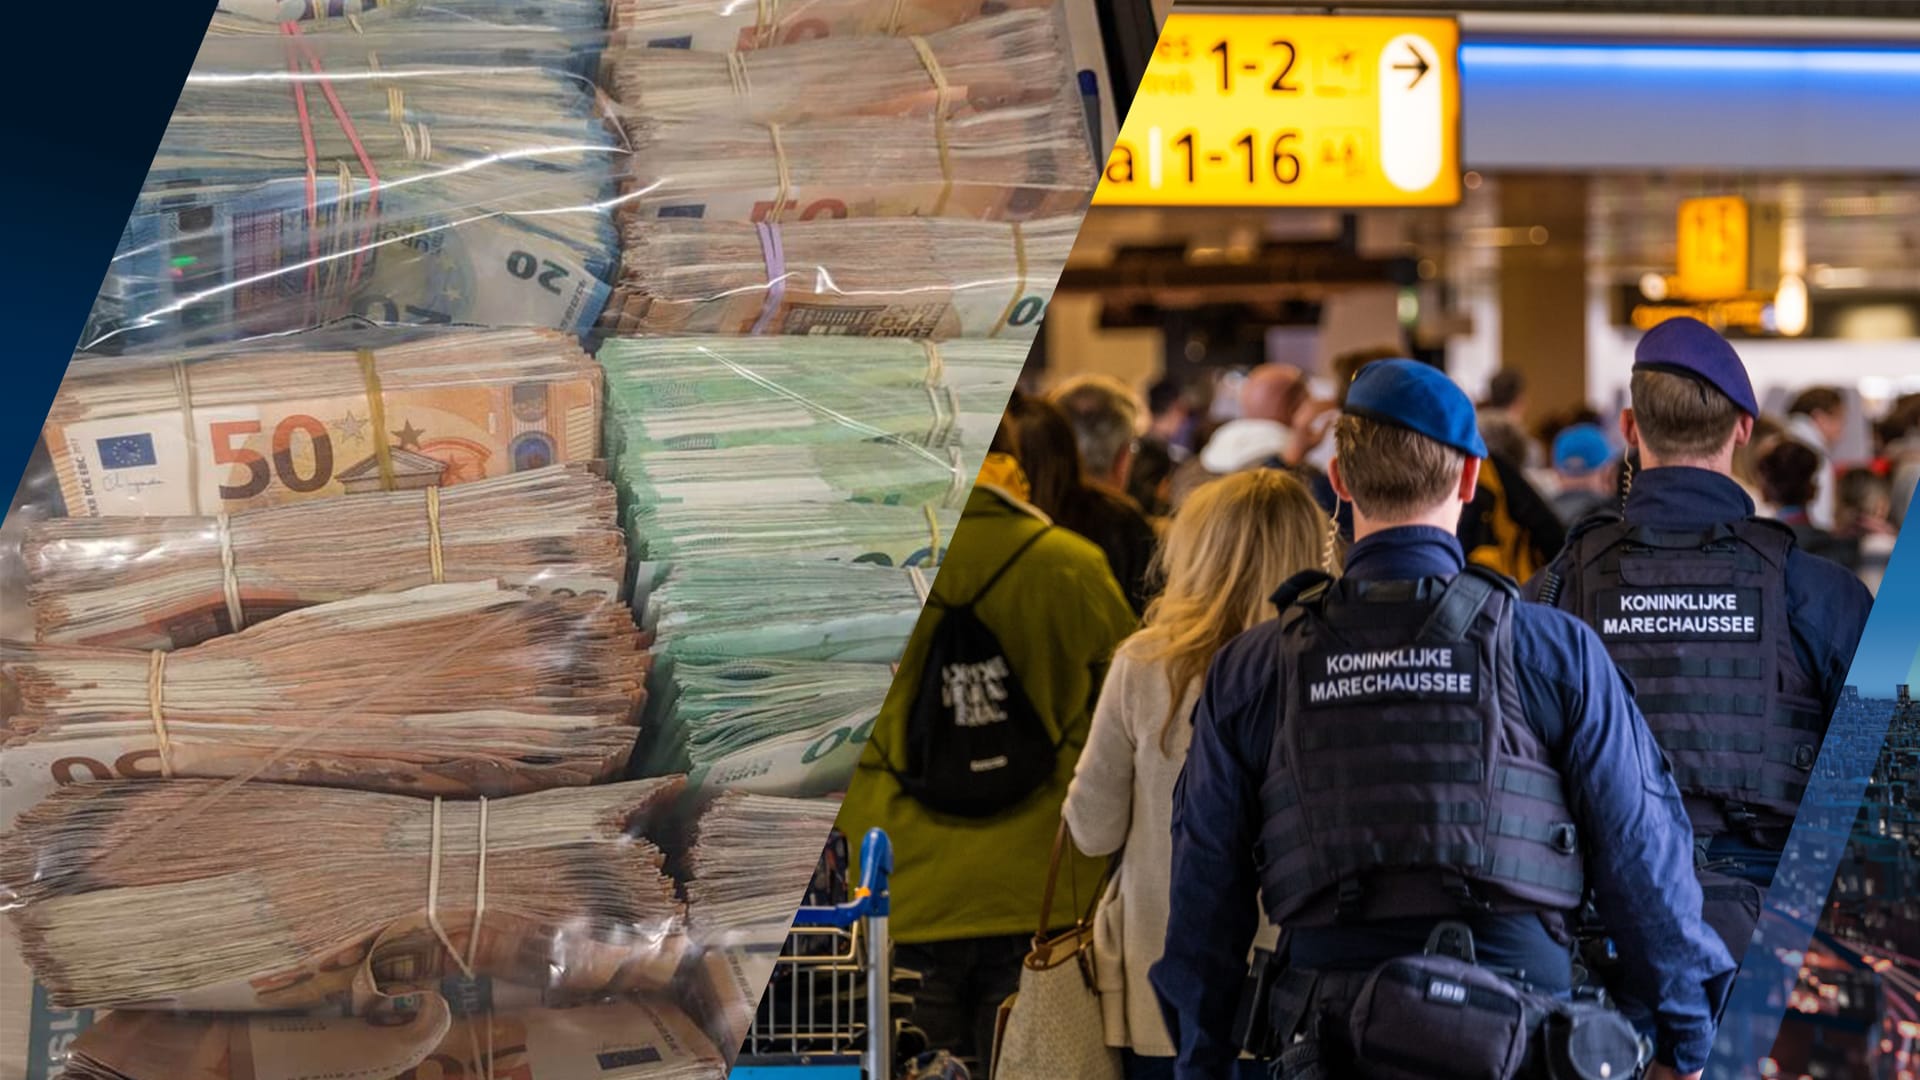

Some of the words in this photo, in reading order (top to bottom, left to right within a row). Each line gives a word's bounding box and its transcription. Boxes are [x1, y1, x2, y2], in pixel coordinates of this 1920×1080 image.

[1211, 40, 1297, 91] 1-2
[1176, 133, 1300, 184] 1-16
[507, 250, 570, 297] 20
[210, 414, 333, 500] 50
[1620, 594, 1737, 612] KONINKLIJKE
[1603, 616, 1755, 634] MARECHAUSSEE
[1327, 648, 1453, 675] KONINKLIJKE
[1310, 673, 1472, 702] MARECHAUSSEE
